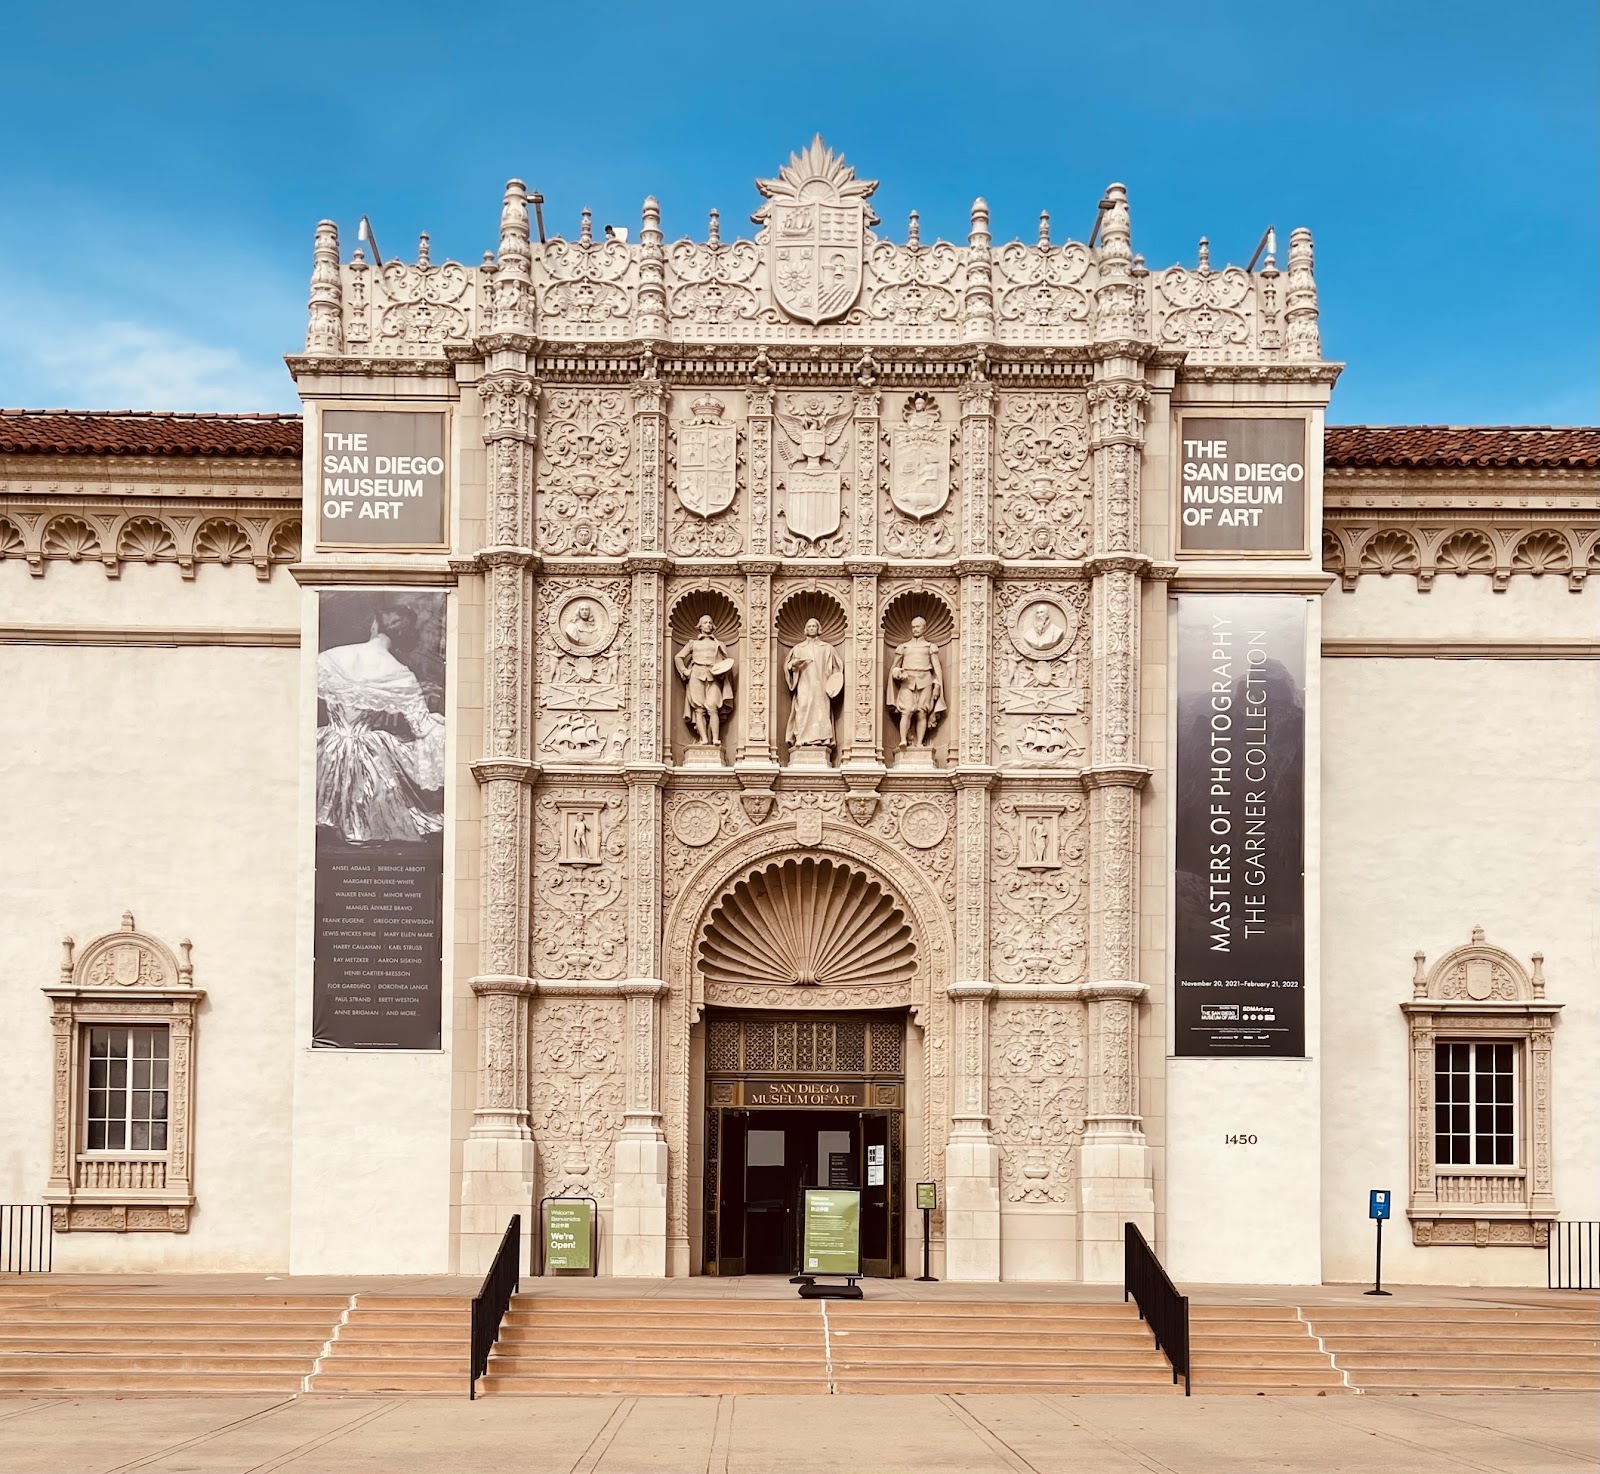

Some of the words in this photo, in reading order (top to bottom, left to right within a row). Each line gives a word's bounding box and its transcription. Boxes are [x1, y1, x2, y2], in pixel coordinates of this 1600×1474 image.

[324, 432, 368, 451] THE
[1184, 440, 1227, 458] THE
[324, 456, 368, 474] SAN
[376, 456, 444, 474] DIEGO
[1183, 462, 1228, 481] SAN
[1234, 464, 1304, 482] DIEGO
[324, 478, 423, 497] MUSEUM
[1184, 486, 1282, 504] MUSEUM
[324, 500, 354, 518] OF
[358, 502, 404, 519] ART
[1183, 508, 1213, 526] OF
[1218, 508, 1262, 526] ART
[1211, 614, 1232, 795] PHOTOGRAPHY
[1246, 630, 1267, 782] COLLECTION
[1210, 804, 1231, 834] OF
[1245, 791, 1266, 886] GARNER
[1210, 844, 1231, 952] MASTERS
[1245, 895, 1266, 939] THE
[770, 1084, 796, 1094] SAN
[799, 1084, 840, 1094] DIEGO
[752, 1094, 808, 1104] MUSEUM
[810, 1095, 828, 1104] OF
[830, 1095, 858, 1105] ART
[1225, 1134, 1258, 1144] 1450
[551, 1241, 576, 1250] Open!
